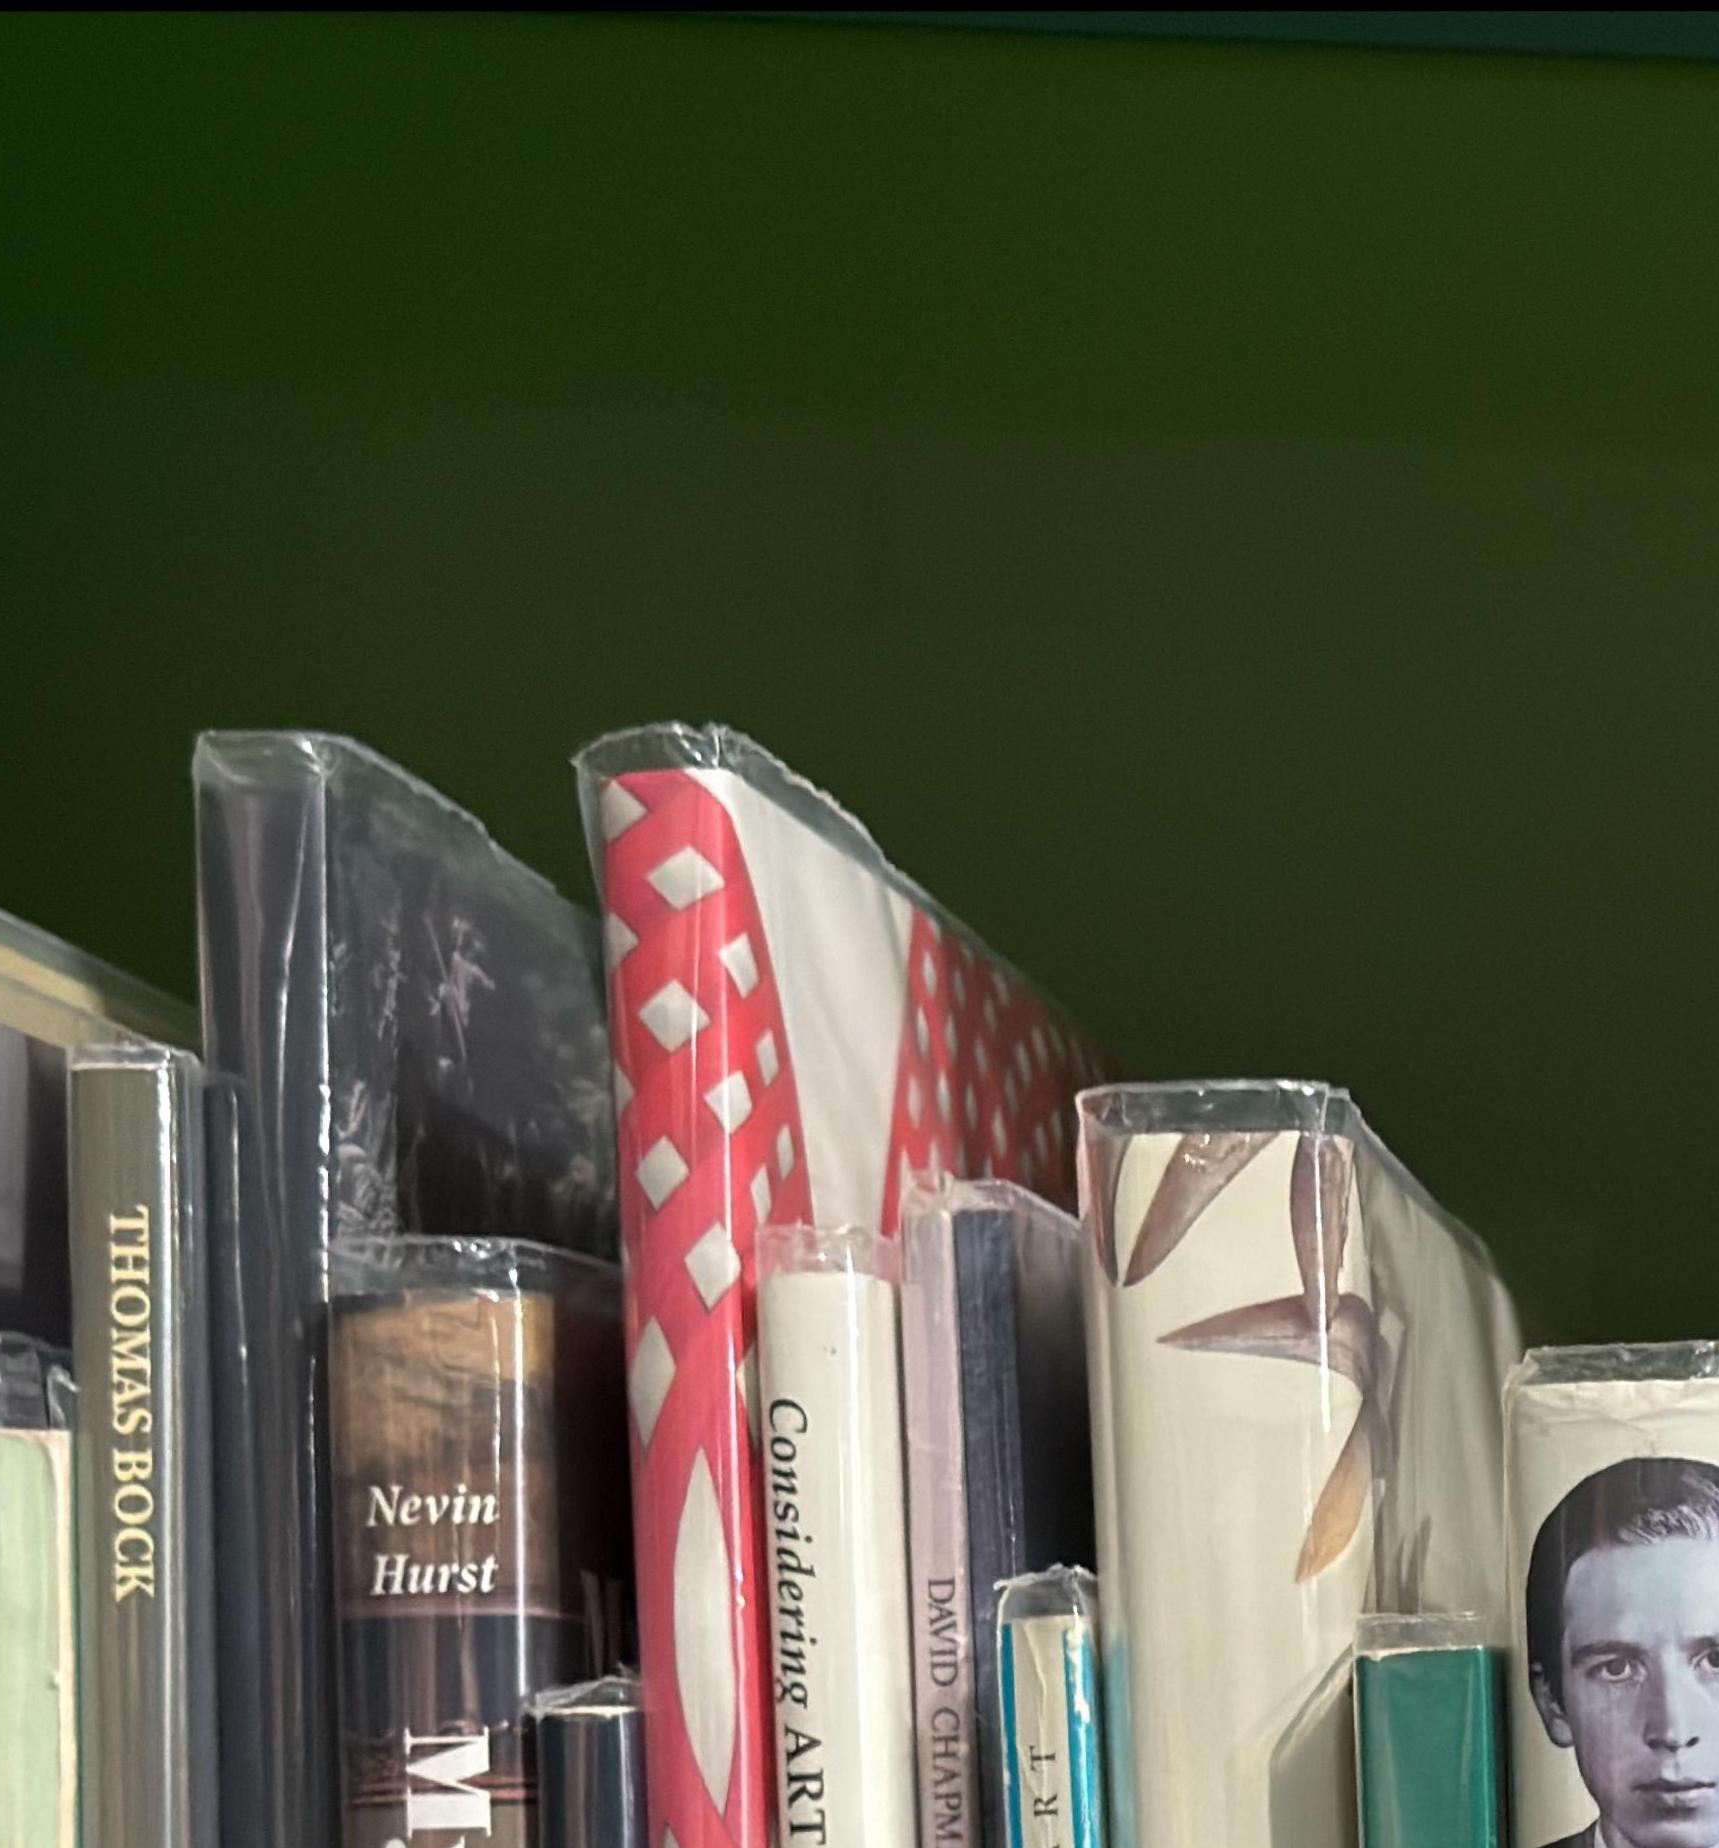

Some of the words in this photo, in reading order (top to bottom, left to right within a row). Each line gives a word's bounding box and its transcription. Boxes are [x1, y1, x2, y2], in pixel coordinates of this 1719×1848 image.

[107, 1205, 153, 1435] THOMAS
[110, 1446, 155, 1602] BOCK
[363, 1486, 499, 1527] Nevin
[766, 1397, 816, 1711] Considering
[369, 1554, 499, 1596] Hurst
[924, 1576, 960, 1688] DAVID
[784, 1724, 829, 1846] ART
